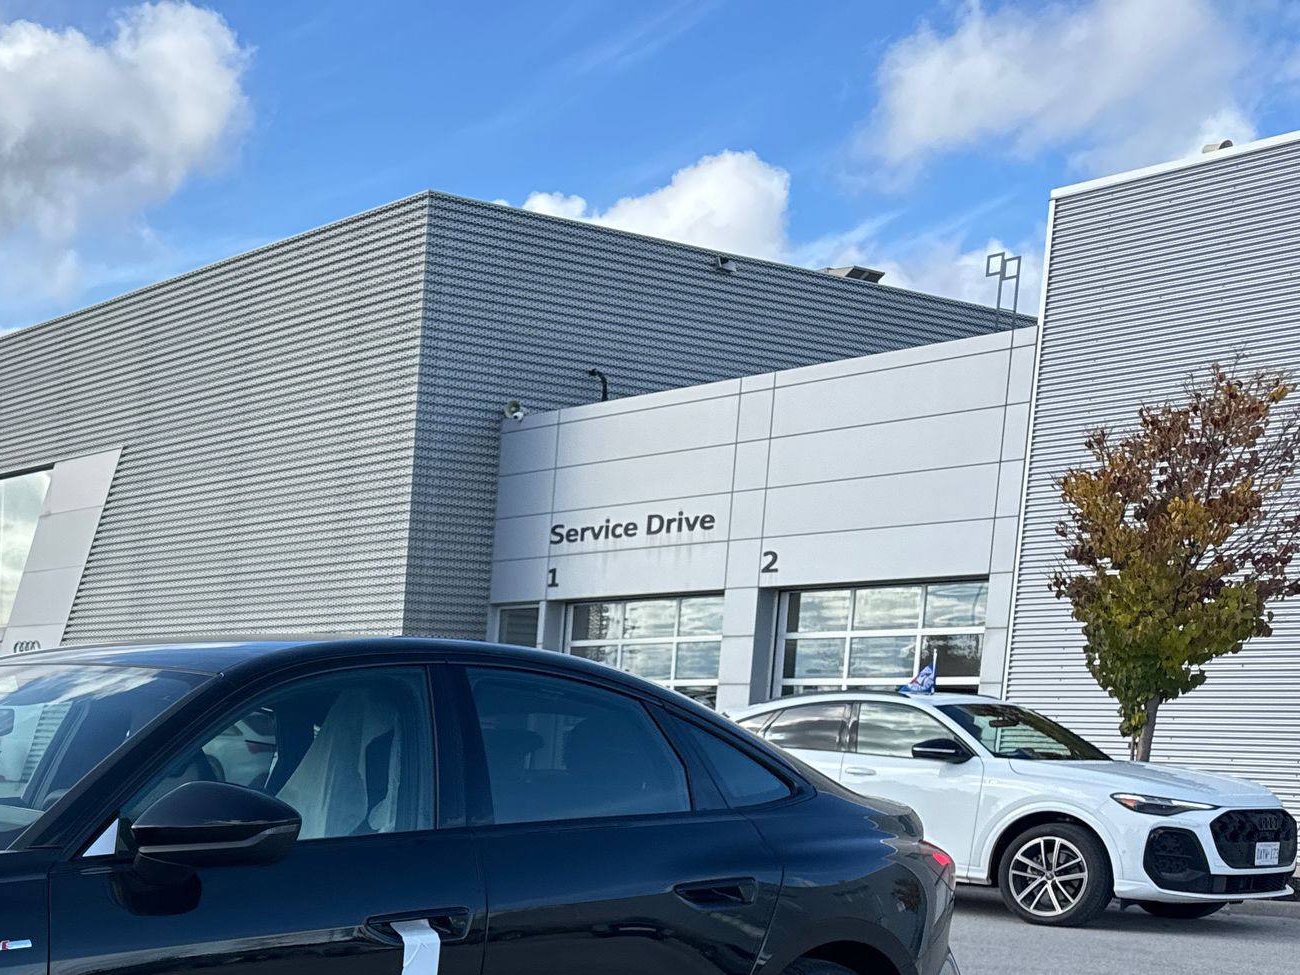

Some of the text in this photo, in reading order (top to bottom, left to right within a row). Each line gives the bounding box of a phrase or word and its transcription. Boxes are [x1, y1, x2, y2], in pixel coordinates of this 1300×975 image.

[549, 510, 716, 545] Service Drive
[760, 550, 779, 574] 2
[547, 568, 559, 588] 1
